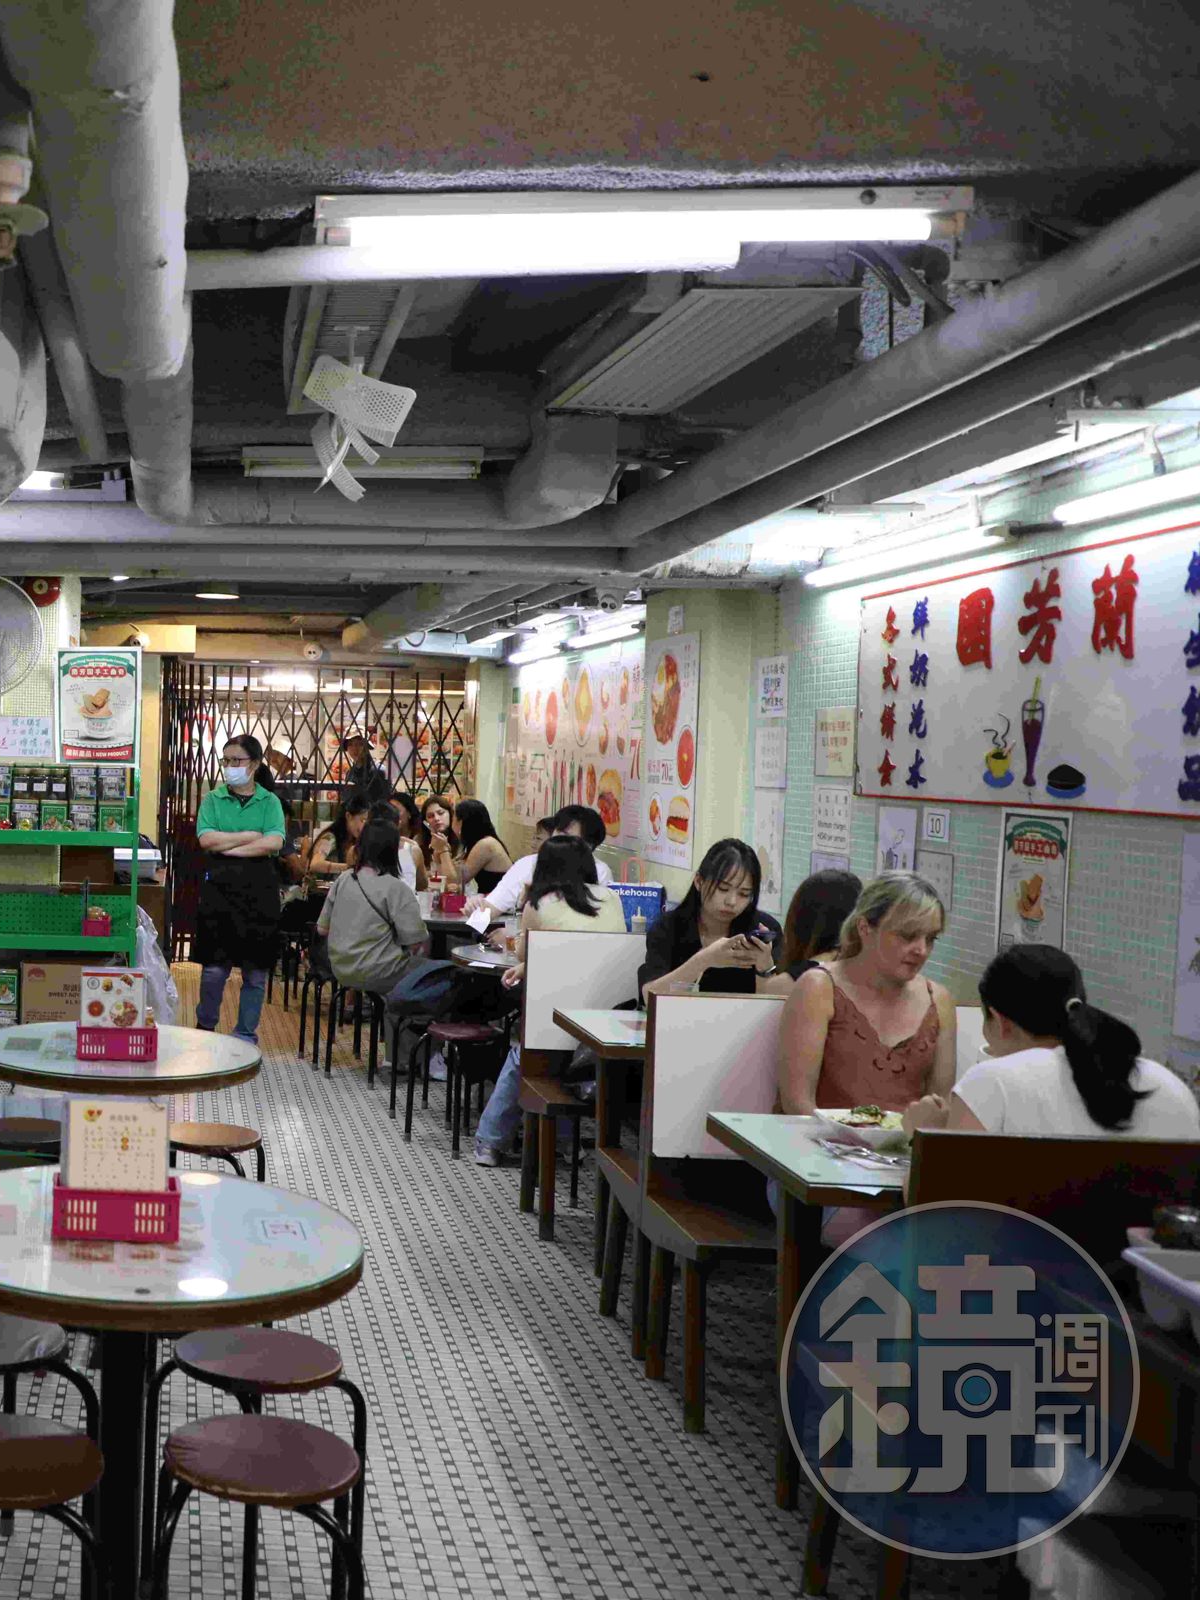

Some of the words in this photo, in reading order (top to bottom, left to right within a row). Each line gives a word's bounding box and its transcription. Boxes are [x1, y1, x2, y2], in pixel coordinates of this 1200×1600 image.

[956, 554, 1139, 670] 蘭芳園
[930, 816, 941, 834] 10
[613, 888, 659, 898] akehouse
